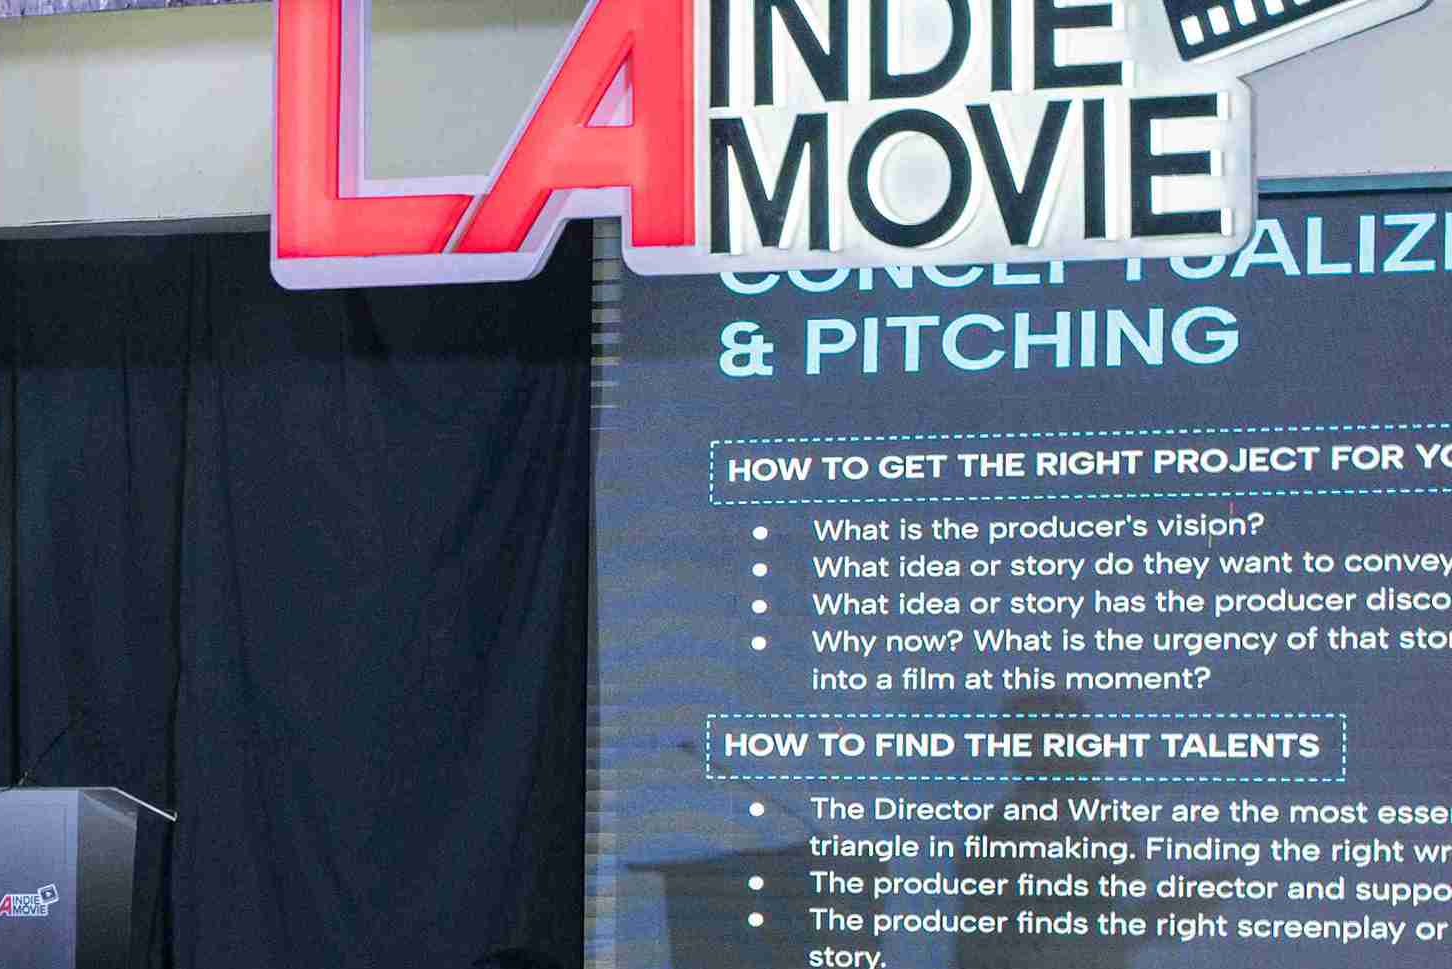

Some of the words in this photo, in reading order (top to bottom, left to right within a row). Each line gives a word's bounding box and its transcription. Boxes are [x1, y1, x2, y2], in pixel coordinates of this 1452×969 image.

[710, 0, 1124, 108] INDIE
[277, 0, 696, 258] LA
[709, 92, 1224, 254] MOVIE
[719, 320, 774, 377] &
[805, 305, 1240, 376] PITCHING
[728, 457, 813, 483] HOW
[821, 456, 869, 481] TO
[878, 454, 948, 479] GET
[957, 452, 1026, 478] THE
[1036, 449, 1144, 477] RIGHT
[1154, 446, 1321, 474] PROJECT
[1331, 444, 1405, 471] FOR
[813, 518, 890, 542] What
[900, 517, 923, 541] is
[931, 517, 980, 540] the
[989, 514, 1149, 545] producer's
[1157, 511, 1265, 537] vision?
[812, 555, 890, 578] What
[899, 554, 961, 578] idea
[970, 559, 1002, 577] or
[1010, 555, 1085, 581] story
[1094, 551, 1134, 576] do
[1142, 551, 1210, 580] they
[1219, 551, 1293, 574] want
[1302, 551, 1335, 573] to
[812, 592, 890, 616] What
[899, 591, 961, 615] idea
[969, 596, 1002, 615] or
[1010, 592, 1085, 619] story
[1094, 589, 1146, 613] has
[1155, 589, 1205, 613] the
[1215, 587, 1357, 618] producer
[811, 629, 877, 658] Why
[886, 629, 964, 653] now?
[973, 628, 1053, 652] What
[1062, 628, 1086, 652] is
[1093, 627, 1144, 651] the
[1153, 631, 1278, 657] urgency
[1286, 625, 1319, 651] of
[1327, 625, 1390, 650] that
[812, 667, 868, 690] into
[875, 673, 893, 690] a
[901, 666, 955, 690] film
[964, 669, 994, 690] at
[1001, 666, 1056, 690] this
[1066, 666, 1211, 690] moment?
[725, 732, 809, 757] HOW
[817, 732, 866, 757] TO
[875, 732, 956, 757] FIND
[963, 733, 1033, 758] THE
[1043, 733, 1150, 758] RIGHT
[1160, 732, 1320, 759] TALENTS
[809, 796, 865, 820] The
[875, 797, 995, 821] Director
[1003, 797, 1058, 822] and
[1067, 798, 1163, 822] Writer
[1171, 803, 1221, 823] are
[1229, 798, 1280, 824] the
[1290, 801, 1369, 824] most
[1377, 805, 1452, 825] esse
[809, 834, 920, 863] triangle
[929, 835, 954, 858] in
[964, 834, 1136, 865] filmmaking.
[1146, 836, 1261, 867] Finding
[1270, 837, 1321, 862] the
[1331, 837, 1405, 868] right
[13, 895, 40, 904] INDIE
[809, 870, 865, 894] The
[874, 871, 1009, 899] producer
[1017, 872, 1089, 897] finds
[1098, 873, 1148, 898] the
[1156, 874, 1279, 900] director
[1287, 875, 1345, 901] and
[13, 904, 47, 914] MOVIE
[808, 907, 864, 931] The
[873, 909, 1009, 937] producer
[1016, 910, 1089, 935] finds
[1097, 911, 1147, 936] the
[1157, 912, 1229, 942] right
[1237, 914, 1407, 945] screenplay
[1415, 921, 1448, 941] or
